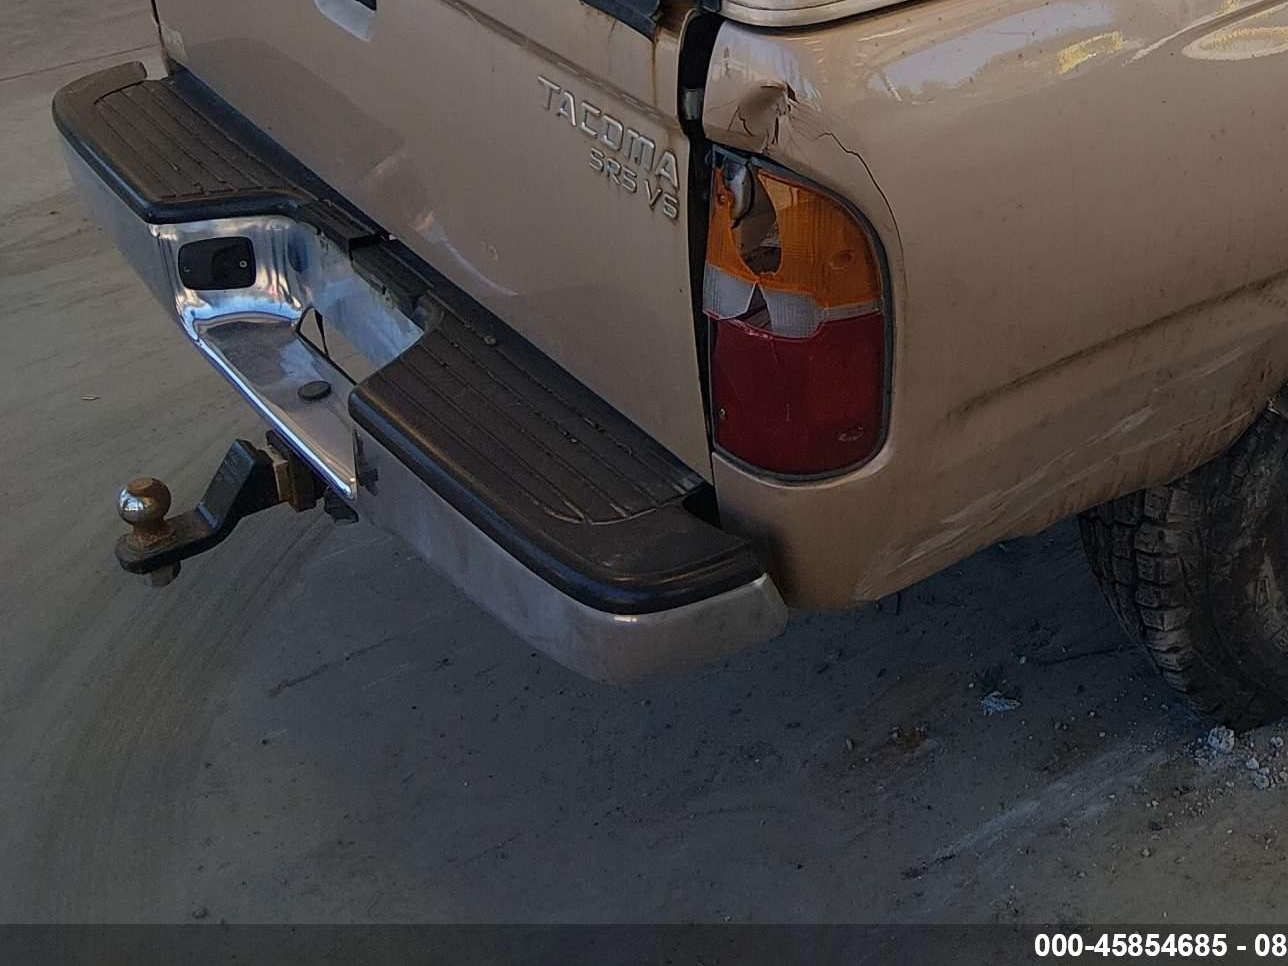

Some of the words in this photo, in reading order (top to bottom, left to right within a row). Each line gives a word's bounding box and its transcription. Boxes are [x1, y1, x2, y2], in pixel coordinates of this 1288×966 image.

[536, 74, 680, 191] TACOMA
[589, 146, 638, 194] SR5
[644, 179, 680, 221] V6
